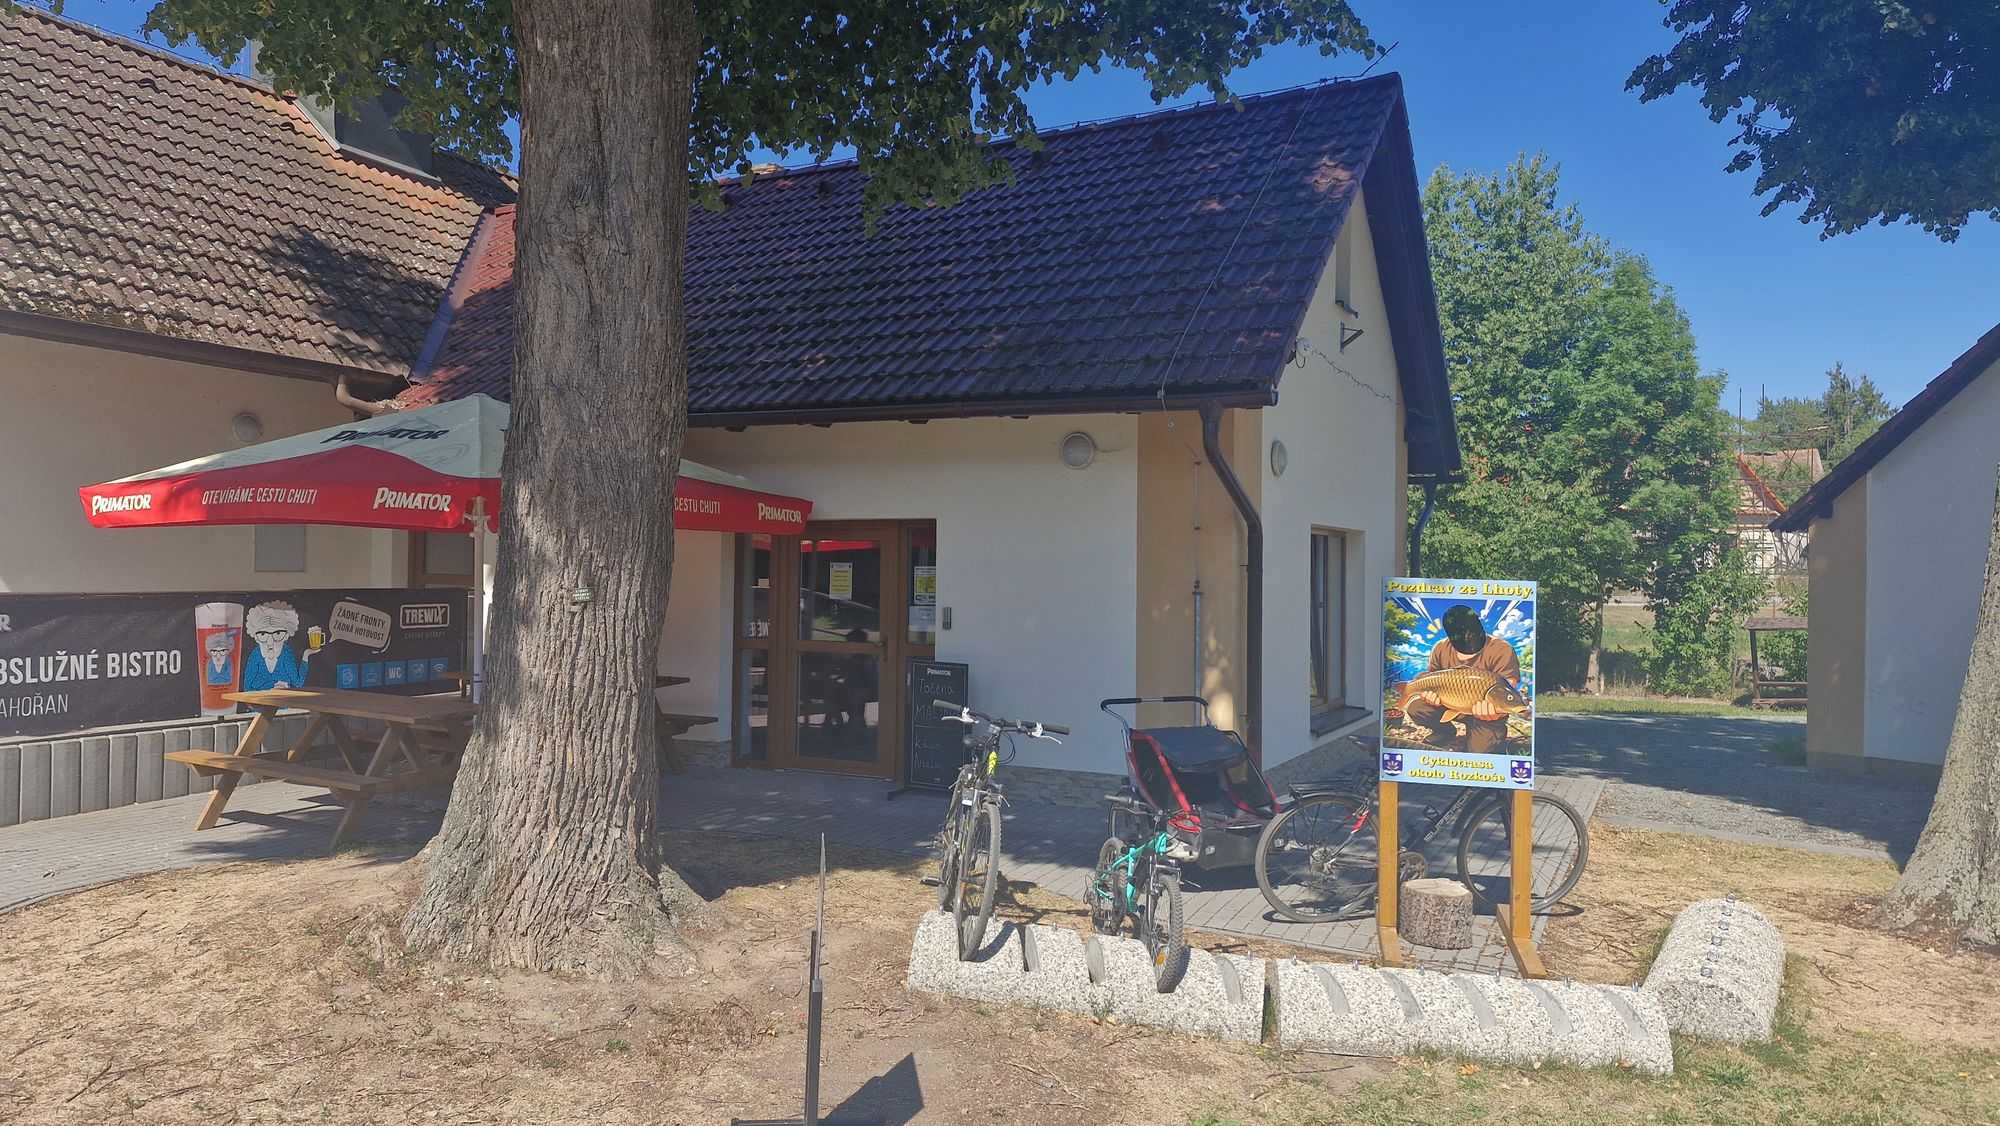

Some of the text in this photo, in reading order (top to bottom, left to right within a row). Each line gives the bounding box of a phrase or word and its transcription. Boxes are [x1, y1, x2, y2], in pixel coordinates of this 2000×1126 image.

[91, 494, 152, 516] PRIMATOR
[202, 487, 318, 505] OTEVÍRÁME CESTU CHUTI
[373, 487, 451, 512] PRIMATOR
[674, 497, 721, 515] CESTU CHUTI
[757, 502, 803, 523] PRIMATOR
[1387, 581, 1533, 599] Pozdrav ze Lhoty
[337, 606, 360, 621] ŽÁDNÉ
[333, 620, 385, 641] ŽÁDNÁ HOTOVOST
[107, 650, 181, 678] BISTRO
[389, 667, 402, 679] WC
[1420, 755, 1494, 769] Cyklotrasa
[1408, 768, 1506, 783] okolo Rozkoše
